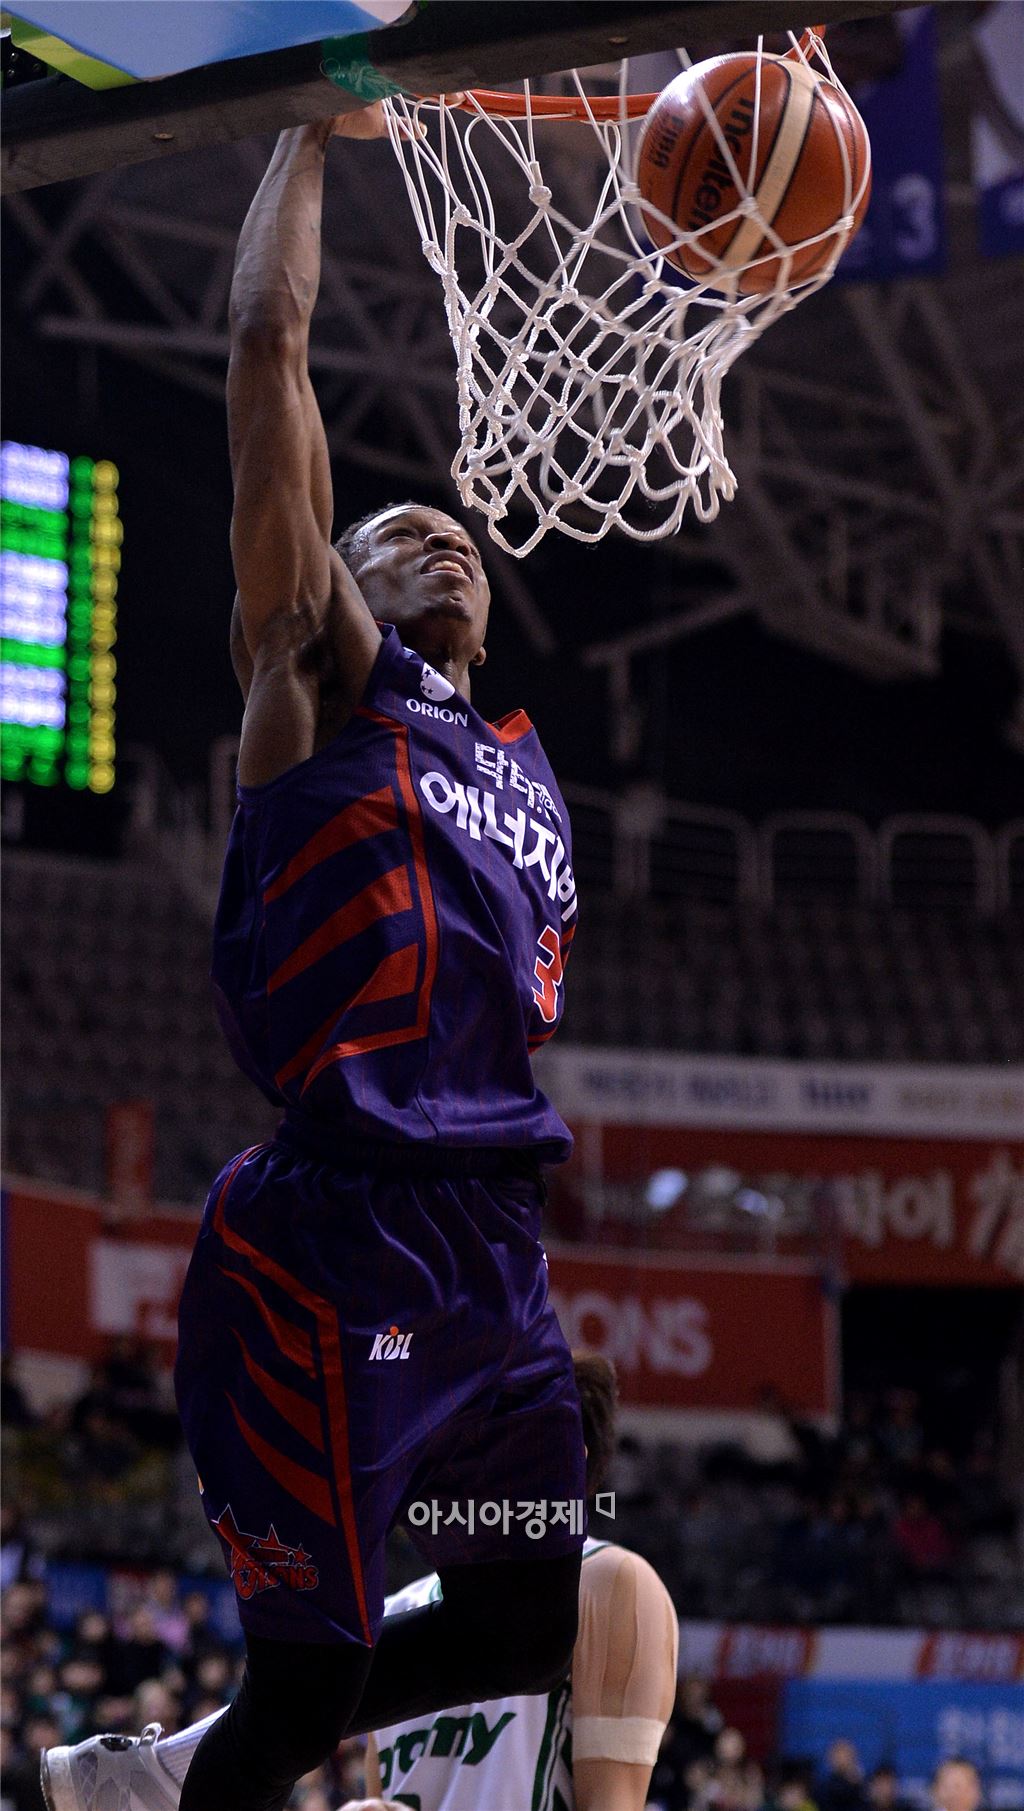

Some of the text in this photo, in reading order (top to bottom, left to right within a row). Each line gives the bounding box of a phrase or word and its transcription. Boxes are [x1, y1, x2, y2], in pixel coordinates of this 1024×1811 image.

[687, 97, 757, 232] molten
[406, 698, 468, 727] ORION
[531, 924, 564, 1023] 3
[368, 1331, 414, 1361] KBL
